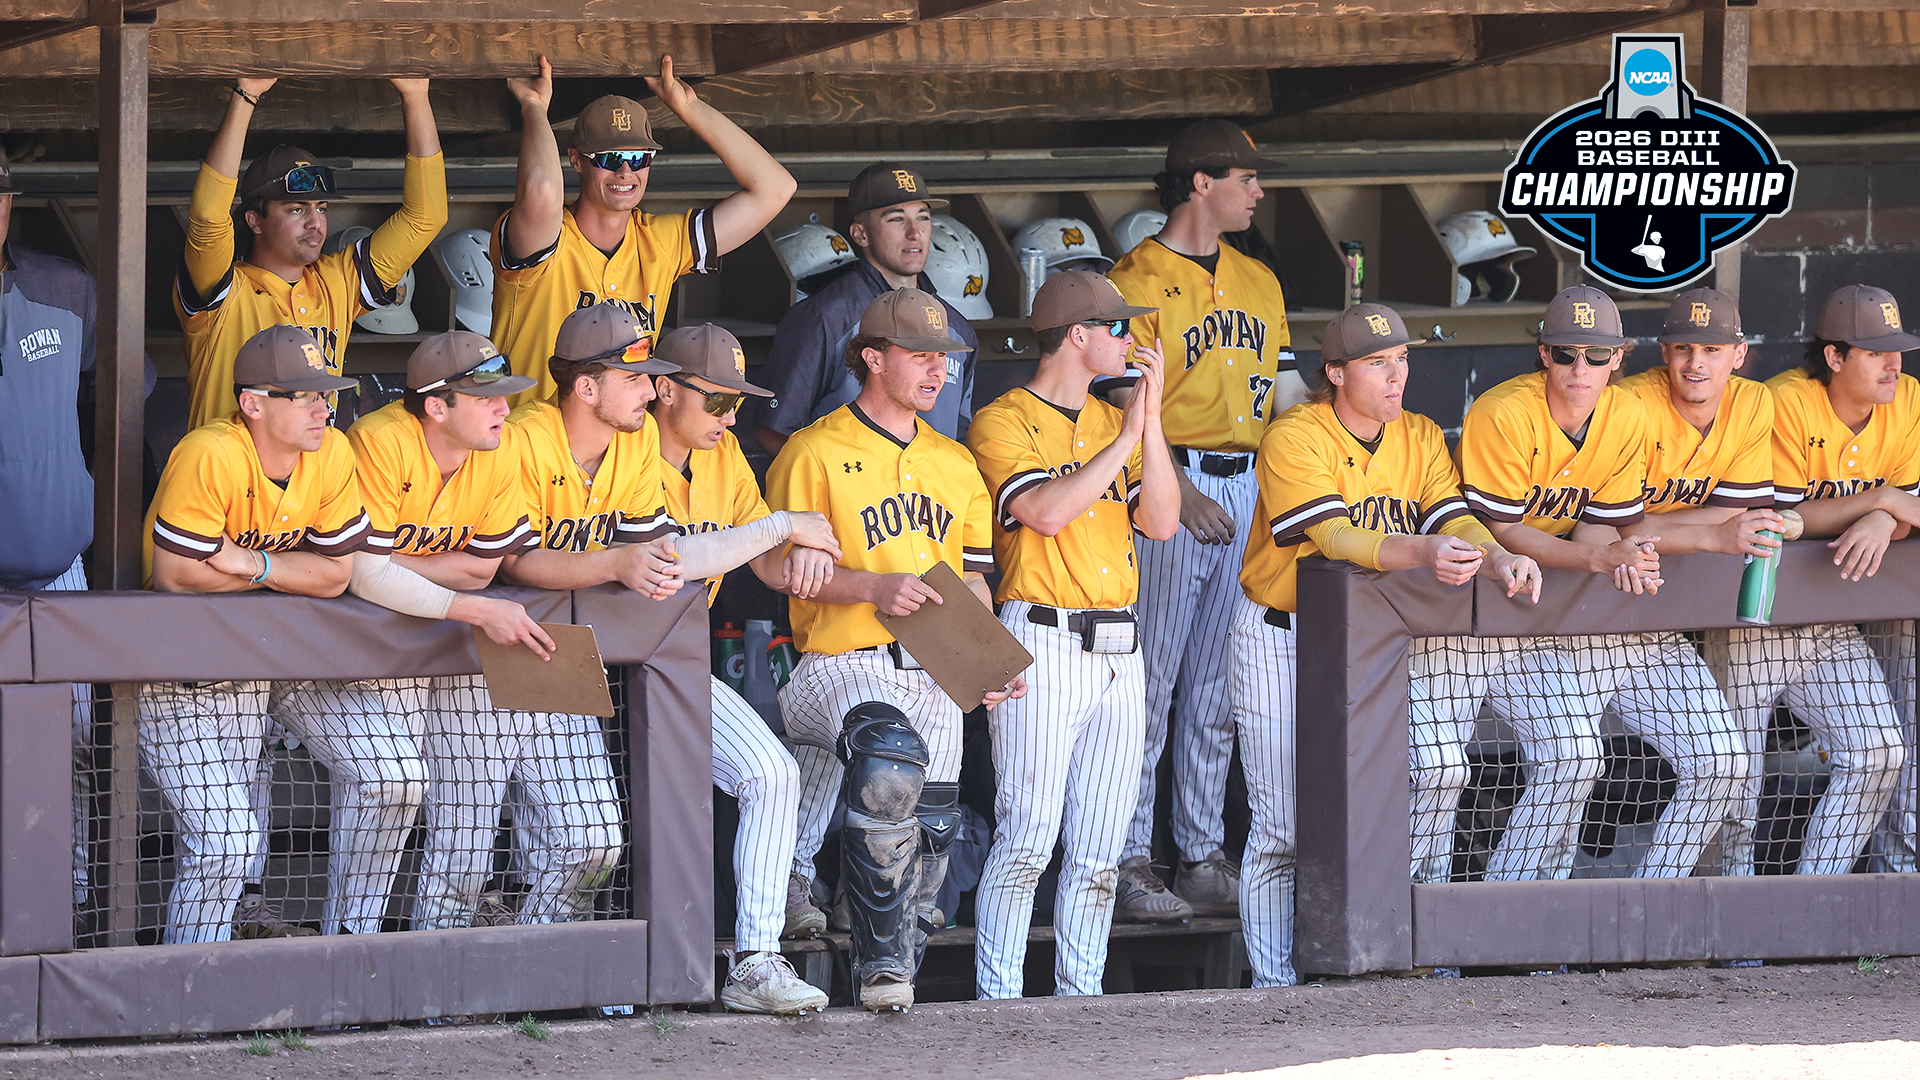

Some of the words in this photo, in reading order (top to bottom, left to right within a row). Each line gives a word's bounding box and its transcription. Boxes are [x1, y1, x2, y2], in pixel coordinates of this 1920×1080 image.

[610, 108, 632, 132] RU
[891, 169, 917, 193] RU
[921, 306, 943, 331] RU
[1364, 313, 1391, 337] RU
[1573, 302, 1596, 329] RU
[1689, 302, 1712, 328] RU
[18, 328, 62, 358] ROWAN
[1181, 308, 1268, 371] ROWAN
[27, 345, 60, 363] BASEBALL
[858, 491, 956, 552] ROWAN
